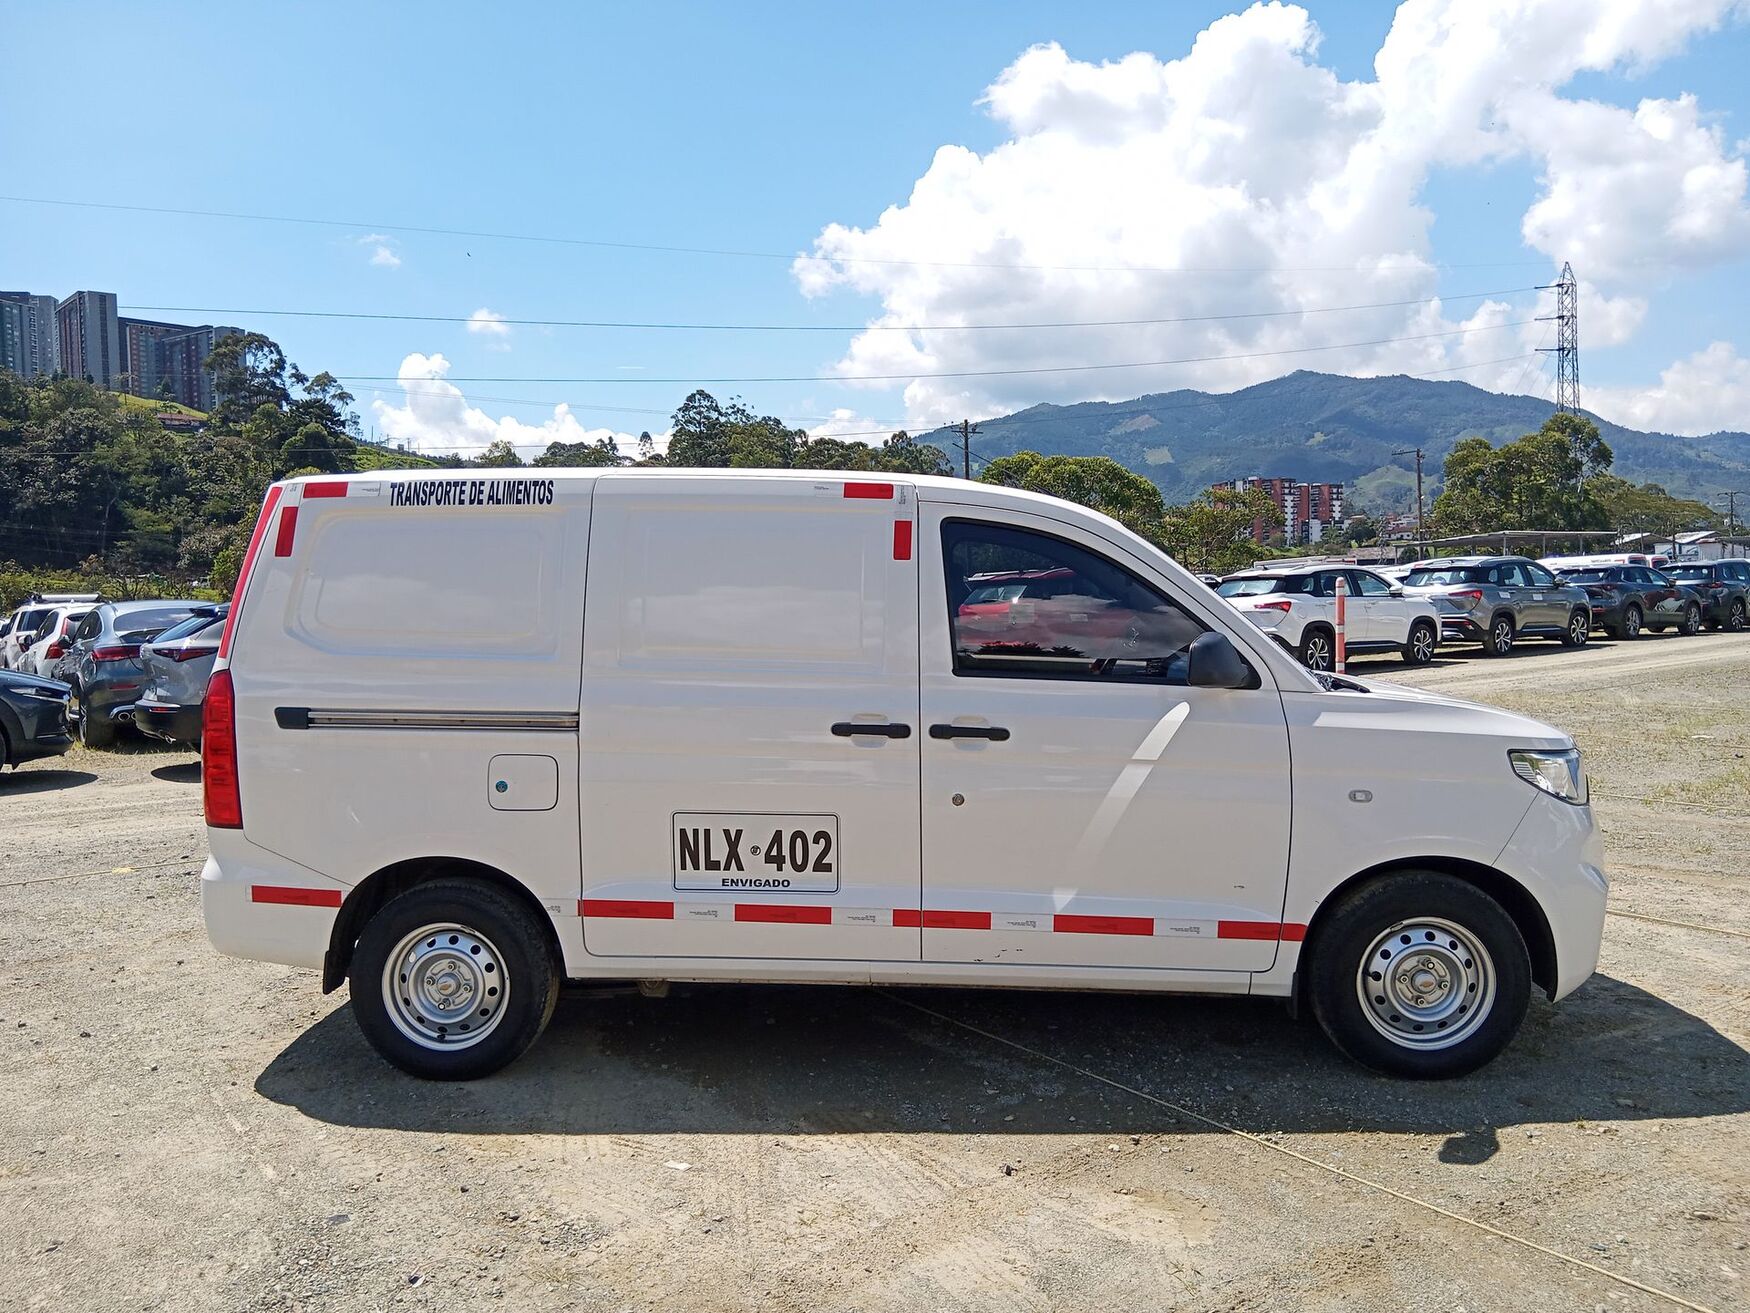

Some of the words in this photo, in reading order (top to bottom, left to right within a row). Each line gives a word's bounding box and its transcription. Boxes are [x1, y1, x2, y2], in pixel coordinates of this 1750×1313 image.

[390, 481, 467, 506] TRANSPORTE
[468, 481, 485, 505] DE
[487, 480, 554, 505] ALIMENTOS
[679, 828, 744, 872] NLX
[764, 829, 833, 873] 402
[721, 878, 790, 888] ENVIGADO
